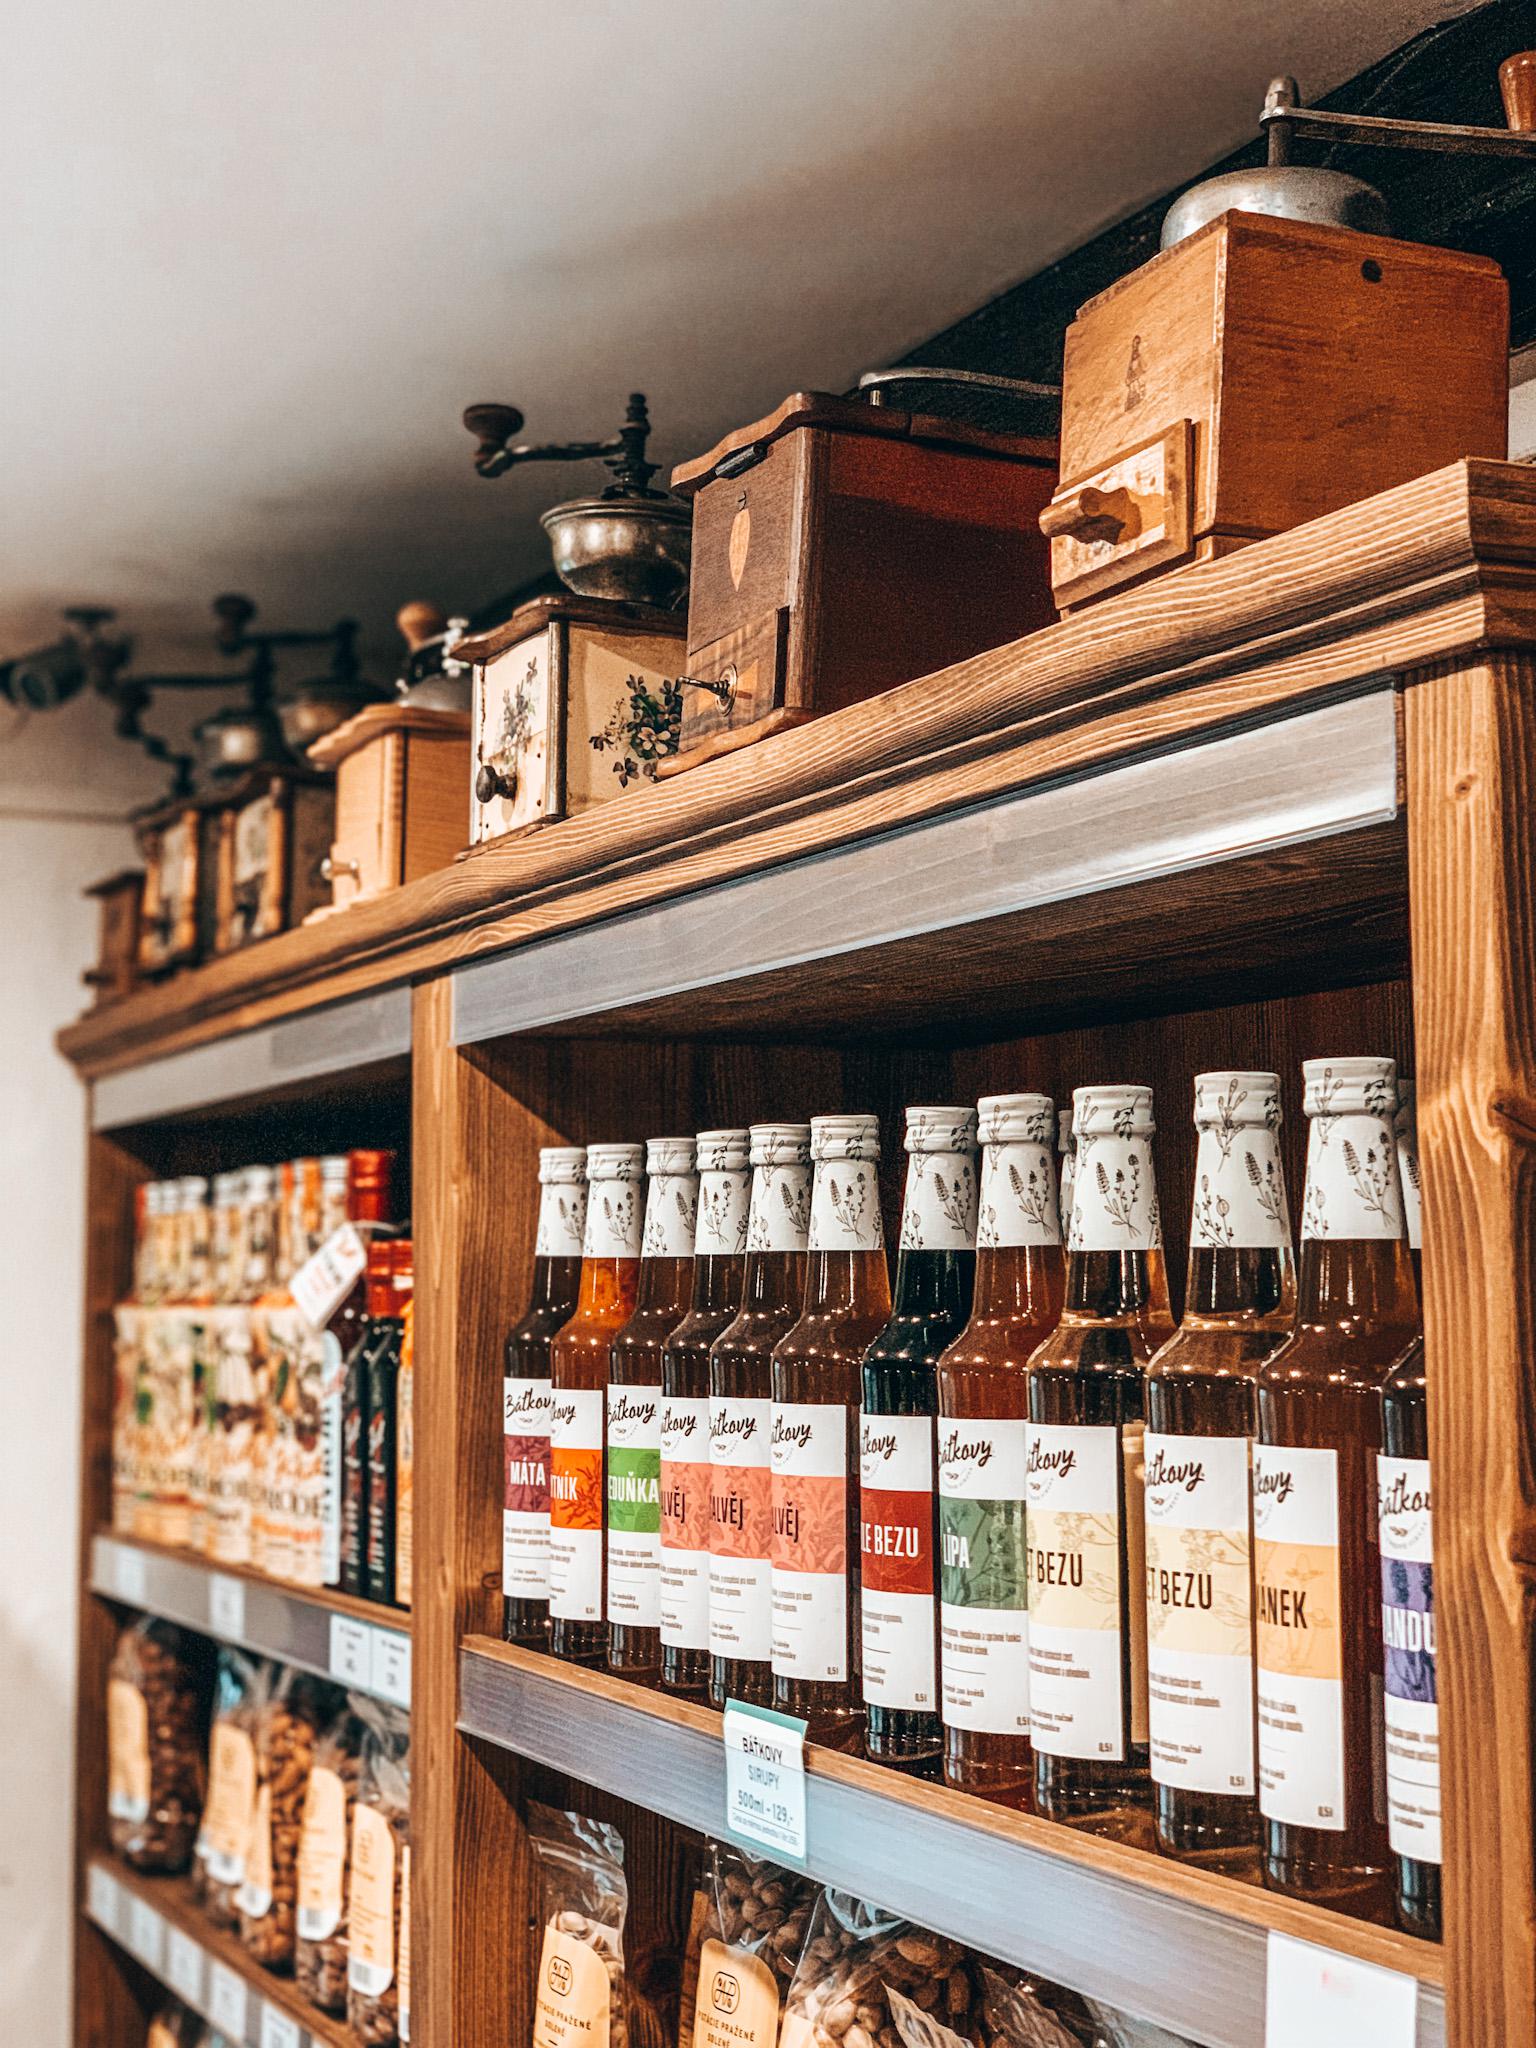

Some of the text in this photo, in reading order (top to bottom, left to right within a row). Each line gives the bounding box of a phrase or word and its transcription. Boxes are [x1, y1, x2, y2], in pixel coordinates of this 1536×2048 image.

[506, 1387, 551, 1418] Báťkov
[510, 1456, 546, 1487] MÁTA
[608, 1471, 660, 1504] EDUŇKA
[709, 1491, 743, 1531] ALVĚJ
[874, 1524, 919, 1558] BEZU
[1036, 1551, 1083, 1587] BEZU
[1160, 1569, 1212, 1610] BEZU
[742, 1735, 783, 1765] BÁŤKOVY
[748, 1765, 780, 1790] SIRUPY
[721, 2021, 755, 2042] PRAŽENÉ
